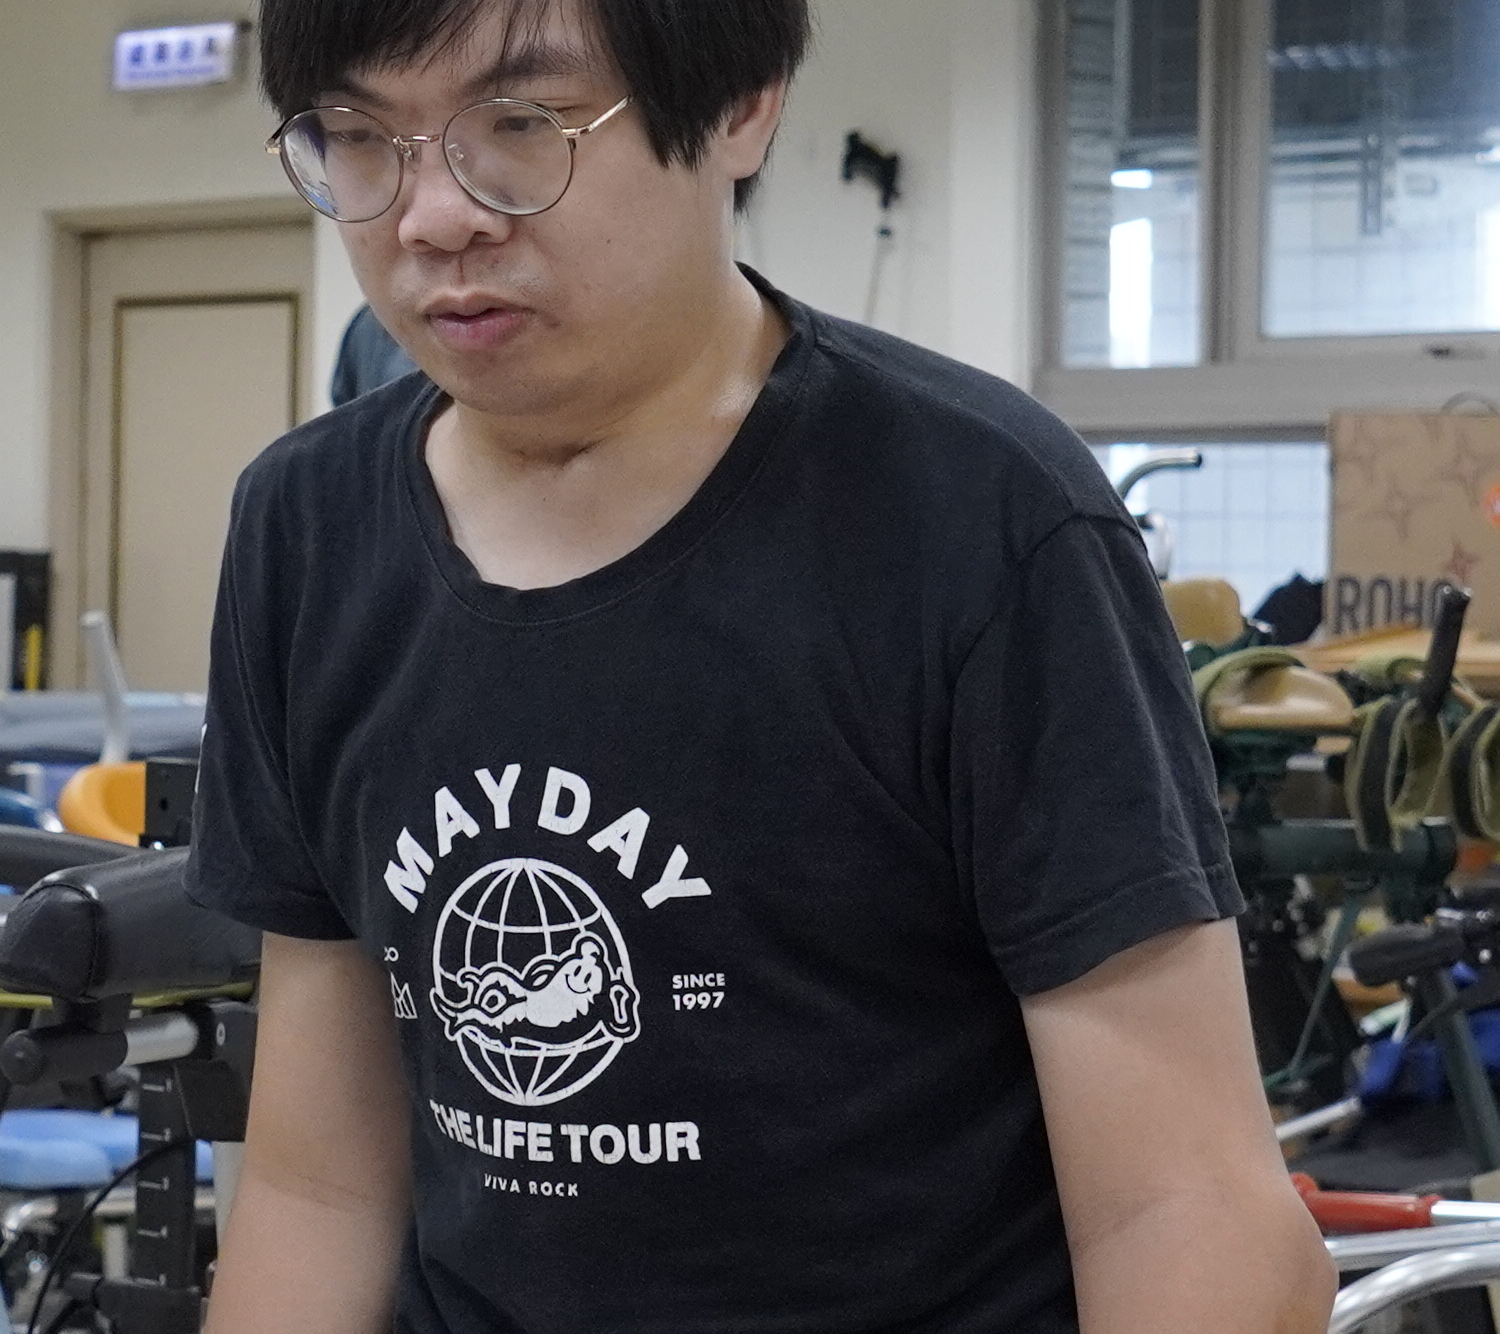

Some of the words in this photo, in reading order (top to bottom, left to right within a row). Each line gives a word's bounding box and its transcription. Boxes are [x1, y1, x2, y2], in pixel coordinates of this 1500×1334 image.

[384, 763, 712, 914] MAYDAY
[672, 973, 725, 989] SINCE
[672, 992, 725, 1010] 1997
[429, 1099, 477, 1150] THE
[476, 1115, 554, 1163] LIFE
[561, 1121, 702, 1165] TOUR
[484, 1173, 520, 1194] VIVA
[529, 1181, 579, 1197] ROCK
